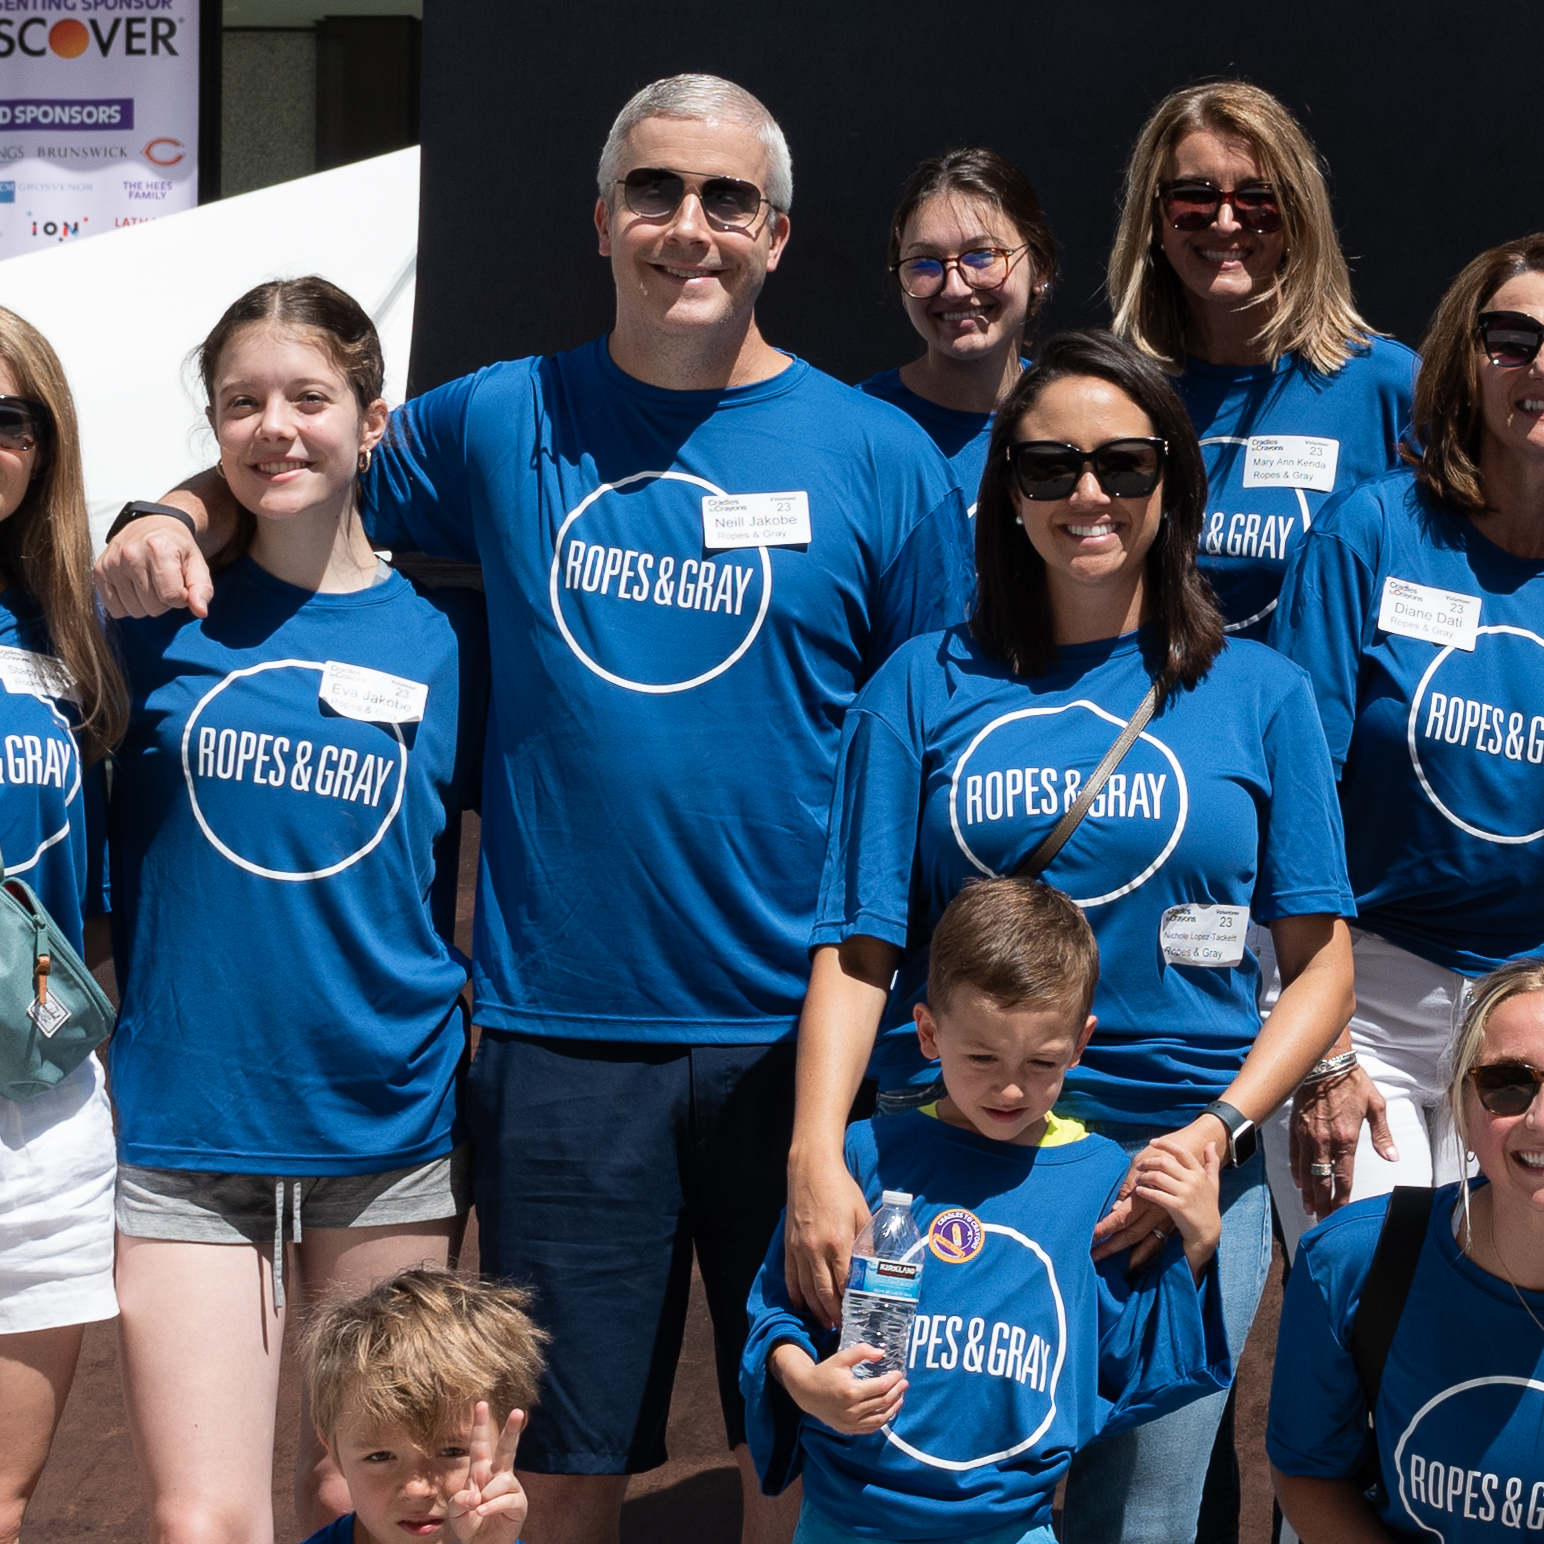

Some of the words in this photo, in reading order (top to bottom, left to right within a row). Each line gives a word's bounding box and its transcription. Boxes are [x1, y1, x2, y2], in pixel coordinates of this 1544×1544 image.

[14, 105, 121, 124] SPONSORS
[37, 146, 129, 158] BRUNSWICK
[18, 182, 93, 192] GROSVENOR
[123, 181, 143, 191] THE
[146, 181, 173, 191] HEES
[129, 191, 167, 200] FAMILY
[1253, 458, 1274, 467] Mary
[1277, 458, 1294, 466] Ann
[715, 517, 744, 528] Neill
[749, 515, 798, 527] Jakobe
[1206, 512, 1224, 555] &
[1227, 513, 1293, 560] GRAY
[565, 539, 652, 601] ROPES
[655, 557, 674, 606] &
[677, 559, 754, 616] GRAY
[1395, 602, 1432, 621] Diane
[1436, 612, 1463, 628] Dati
[332, 683, 358, 697] Eva
[363, 691, 412, 712] Jakobe
[1425, 691, 1505, 755] ROPES
[1506, 712, 1527, 760] &
[5, 735, 73, 789] GRAY
[198, 726, 287, 787] ROPES
[291, 737, 311, 791] &
[314, 745, 394, 808] GRAY
[1219, 917, 1233, 927] 23
[1164, 931, 1189, 940] Nichole
[1410, 1454, 1498, 1520] ROPES
[1503, 1476, 1525, 1528] &
